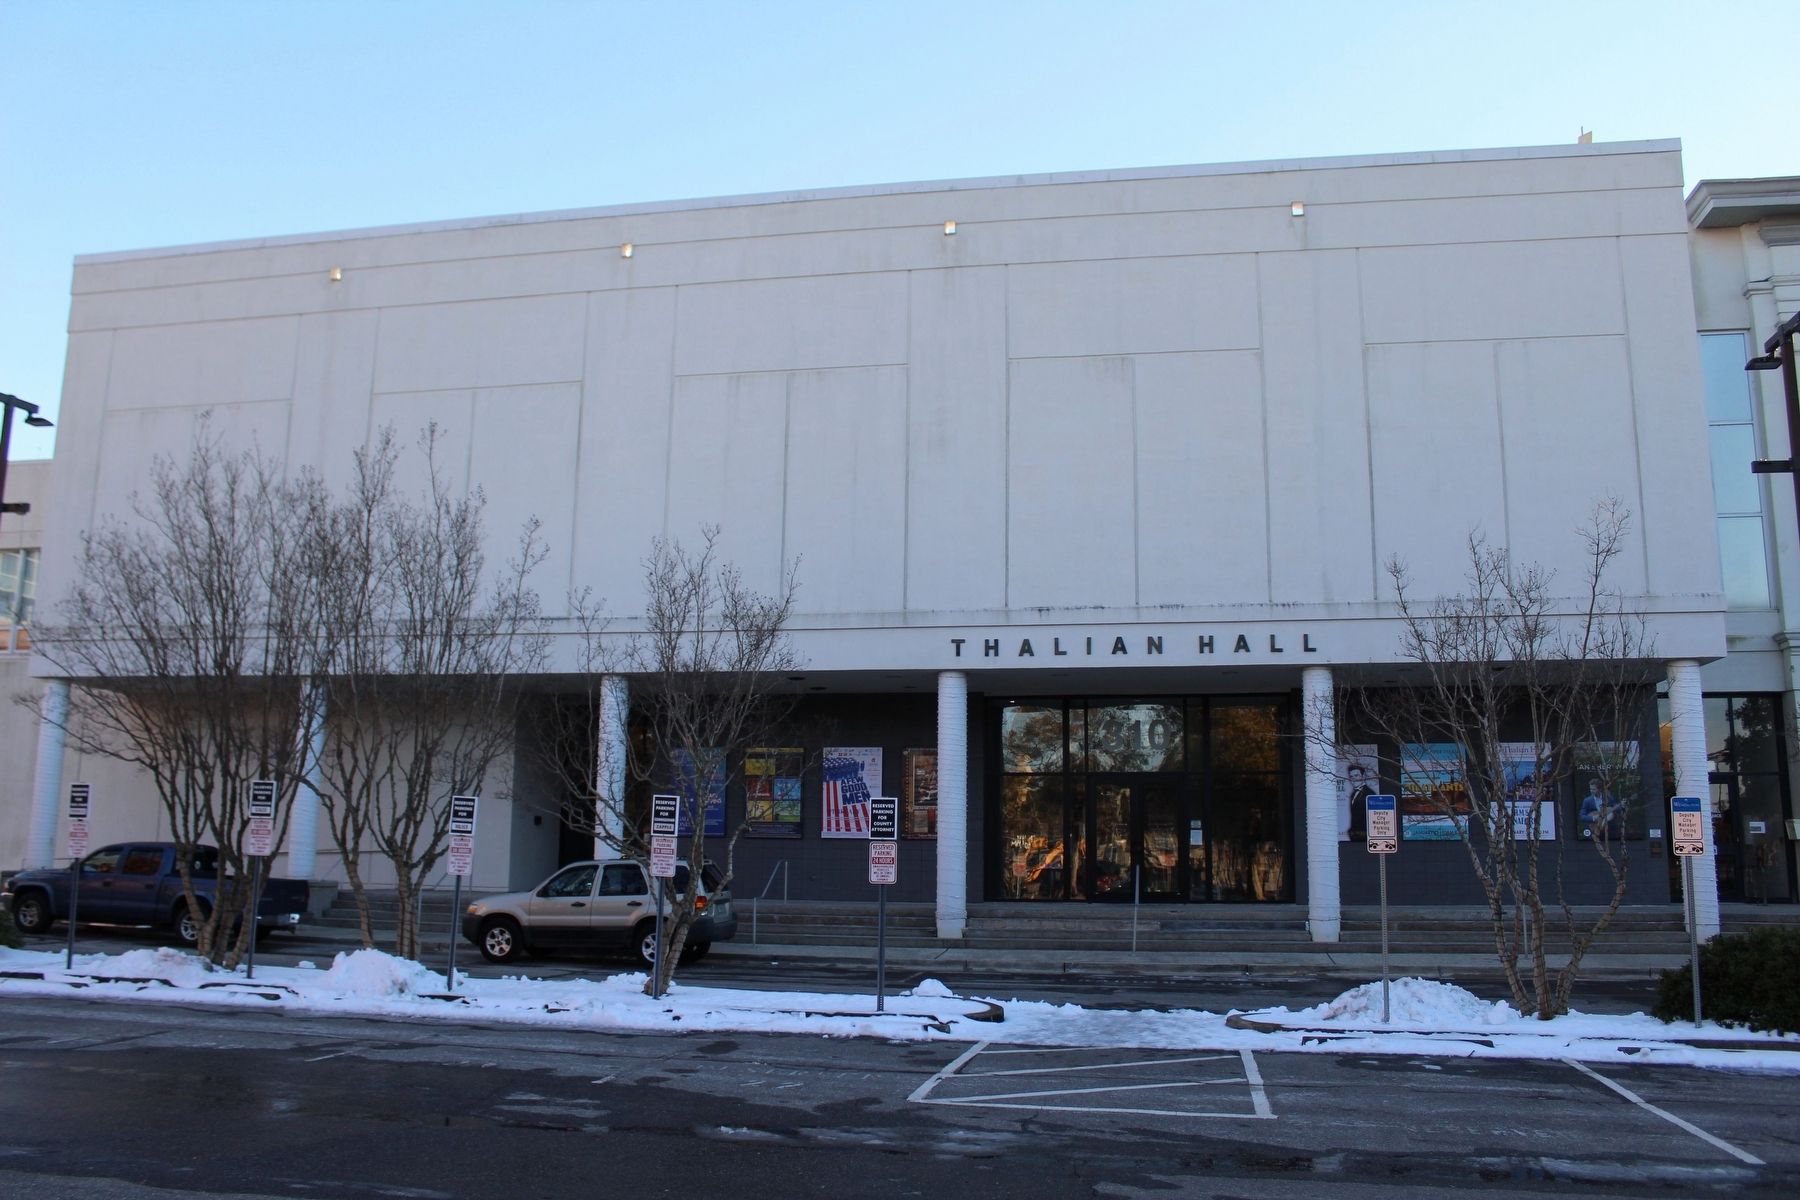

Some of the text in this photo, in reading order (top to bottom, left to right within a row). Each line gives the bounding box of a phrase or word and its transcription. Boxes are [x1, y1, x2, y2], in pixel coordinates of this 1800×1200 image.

[951, 633, 1317, 657] THALIAN HALL
[1103, 719, 1170, 752] 310
[840, 775, 864, 786] A FEW
[841, 782, 868, 794] GOOD
[842, 790, 871, 805] MEN
